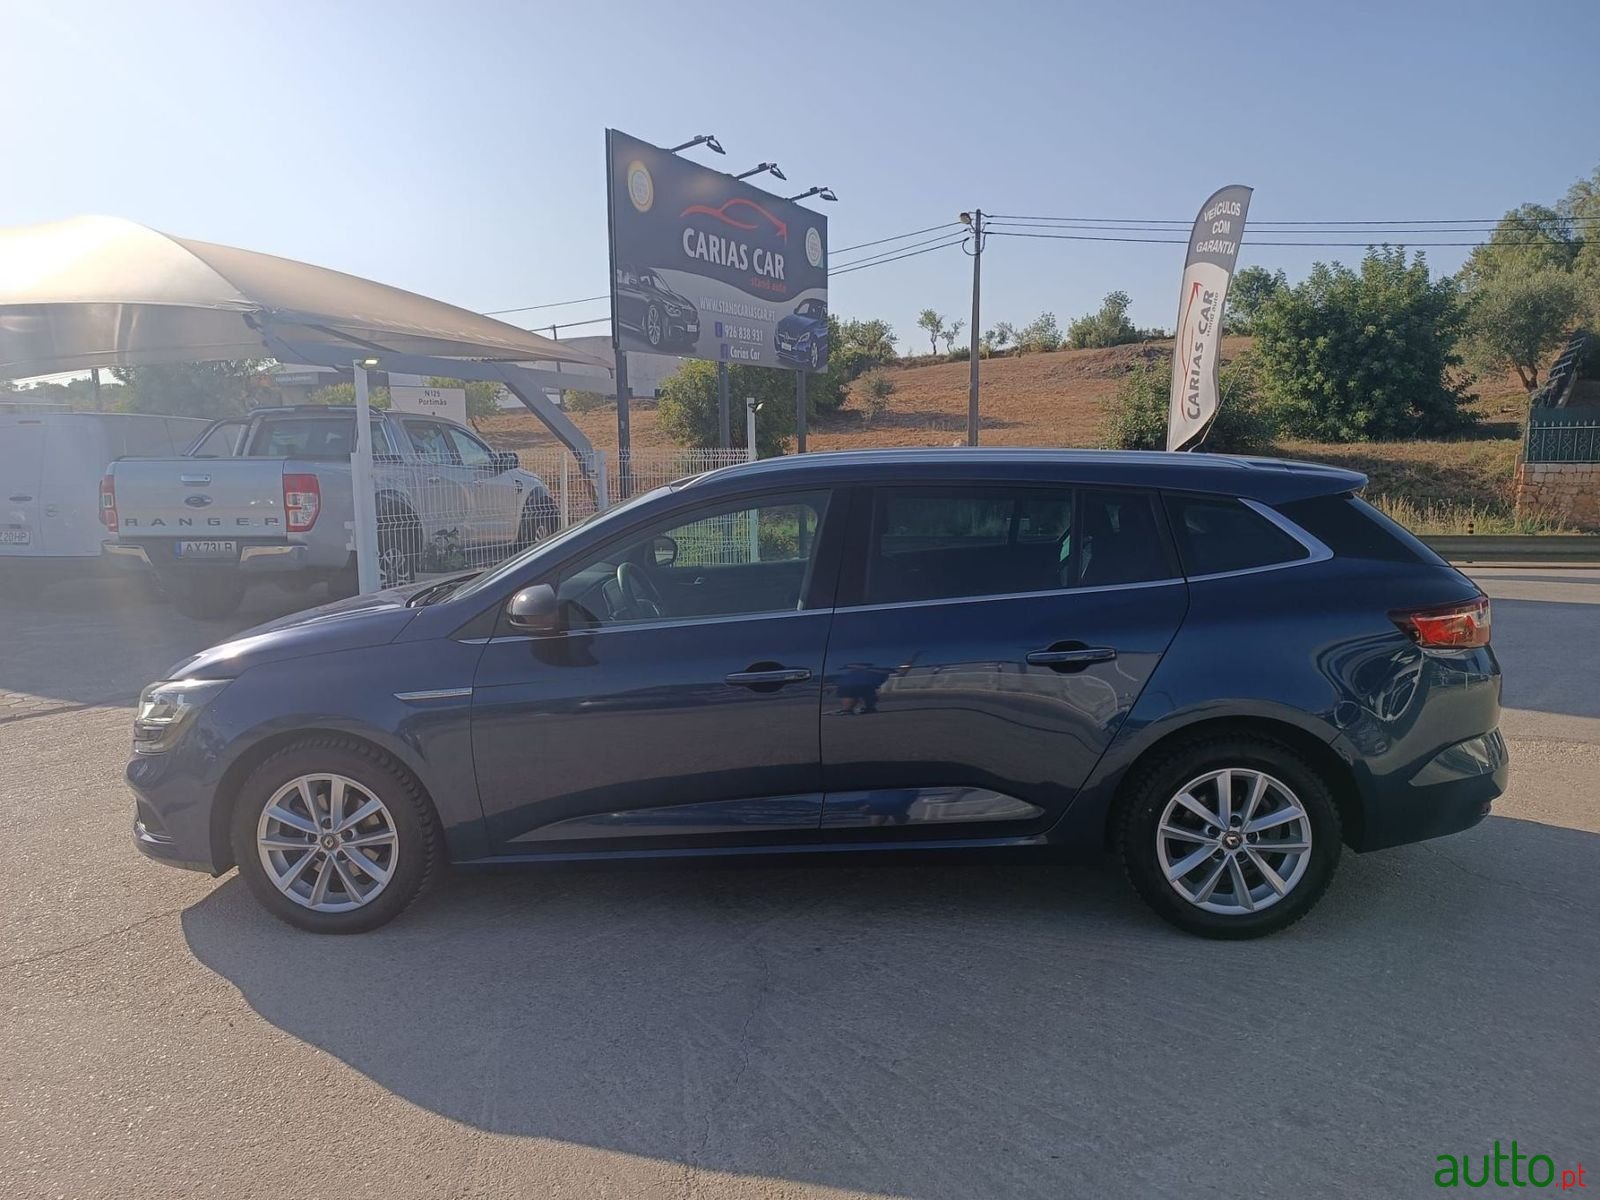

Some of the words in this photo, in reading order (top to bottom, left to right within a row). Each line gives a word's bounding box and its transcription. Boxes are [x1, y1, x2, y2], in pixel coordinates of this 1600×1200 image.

[1212, 219, 1231, 234] COM
[682, 227, 749, 271] CARIAS
[753, 248, 785, 280] CAR
[1196, 239, 1236, 255] GARANTIA
[730, 345, 749, 360] Carias
[750, 348, 761, 361] Car
[1187, 342, 1204, 420] CARIAS
[1198, 290, 1215, 335] CAR
[124, 517, 280, 527] RANGER
